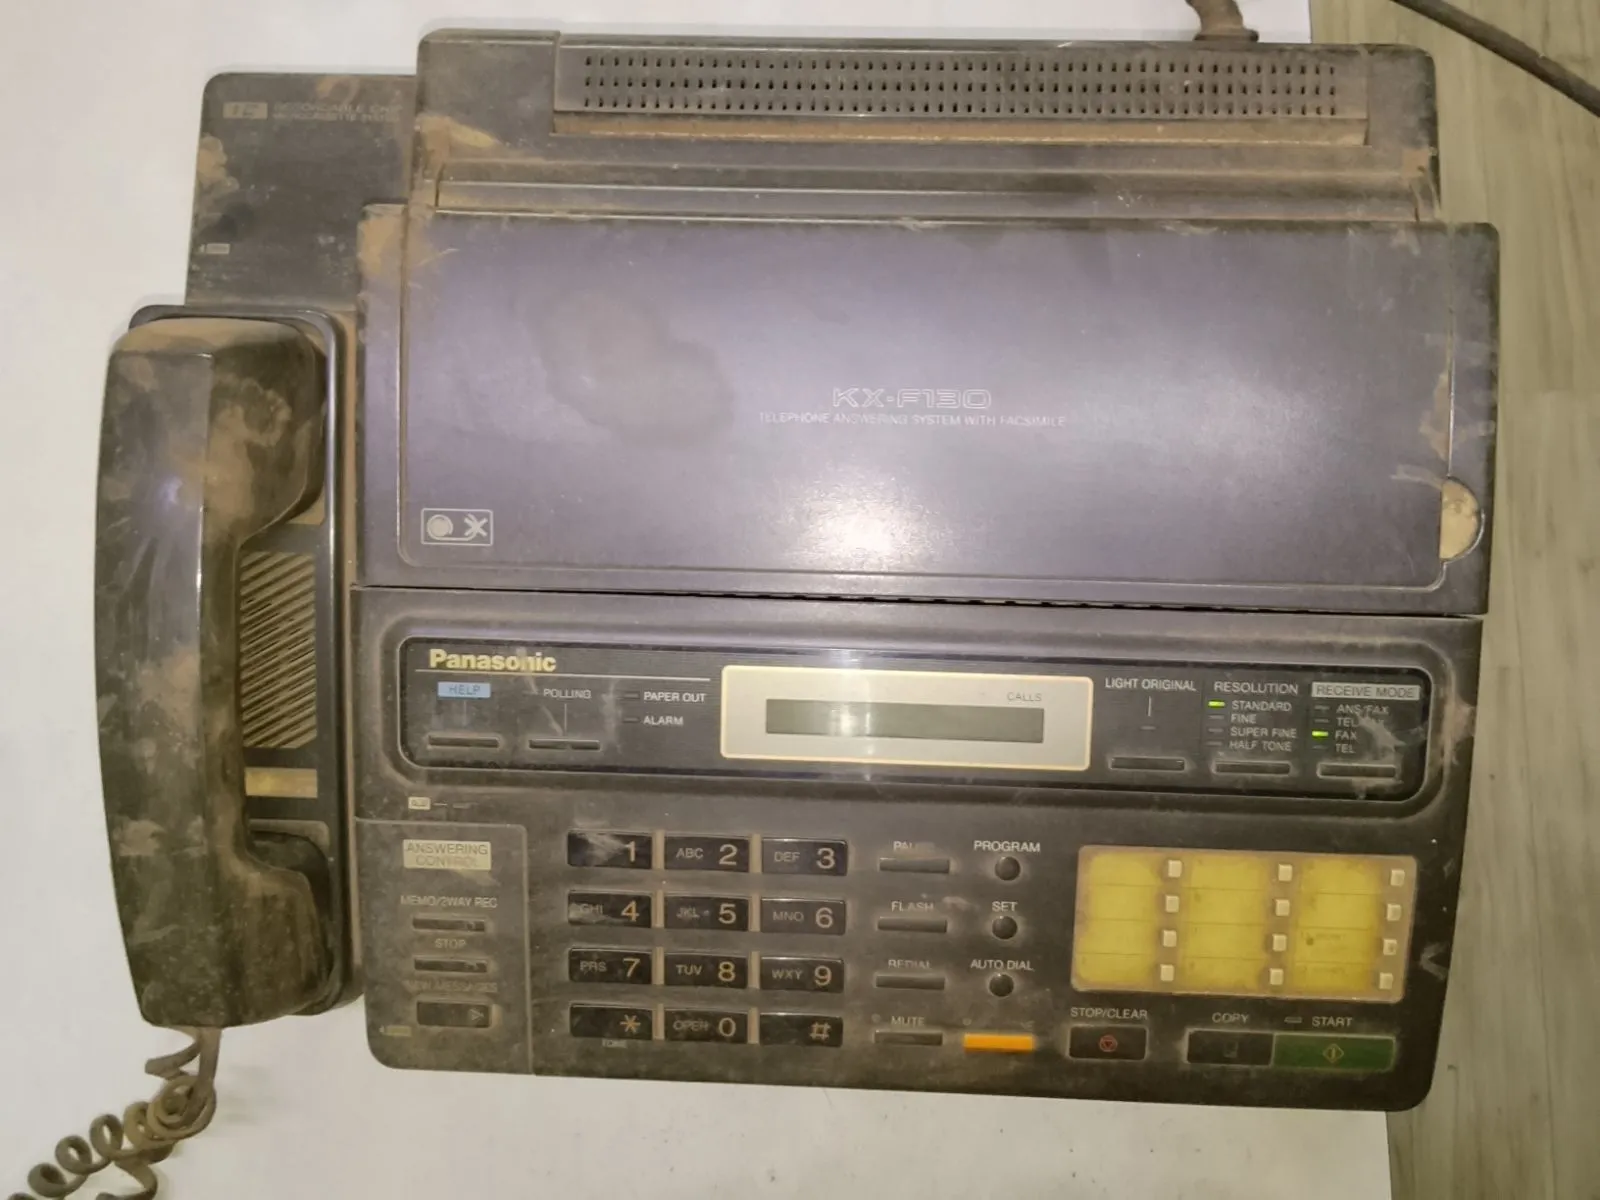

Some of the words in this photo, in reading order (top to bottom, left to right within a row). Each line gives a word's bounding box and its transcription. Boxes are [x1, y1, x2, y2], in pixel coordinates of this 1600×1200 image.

[831, 387, 992, 410] KX-F130
[759, 411, 831, 424] TELEPHONE
[911, 414, 961, 426] SYSTEM
[964, 415, 996, 428] WITH
[999, 416, 1066, 428] FACSIMILE
[429, 648, 557, 673] Panasonic
[448, 683, 481, 696] HELP
[1104, 677, 1138, 690] LIGHT
[1141, 678, 1197, 692] ORIGINAL
[1213, 681, 1299, 695] RESOLUTION
[542, 688, 592, 700] POLLING
[643, 691, 680, 703] PAPER
[683, 693, 706, 704] OUT
[1006, 691, 1043, 702] CALLS
[1316, 684, 1372, 698] RECEIVE
[1375, 686, 1416, 699] MODE
[1231, 700, 1293, 712] STANDARD
[643, 715, 684, 727] ALARM
[1230, 713, 1257, 724] FINE
[1229, 726, 1269, 738] SUPER
[1271, 727, 1297, 739] FINE
[1334, 729, 1357, 741] FAX
[1228, 739, 1258, 751] HALF
[1262, 740, 1293, 753] TONE
[1335, 743, 1356, 754] TEL
[406, 842, 489, 856] ANSWERING
[625, 840, 637, 862] 1
[973, 840, 1041, 853] PROGRAM
[675, 847, 704, 860] ABC
[718, 843, 739, 866] 2
[773, 851, 800, 863] DEF
[815, 847, 836, 869] 3
[474, 897, 498, 909] REC
[891, 901, 934, 912] FLASH
[991, 901, 1018, 912] SET
[620, 900, 640, 922] 4
[676, 907, 699, 919] JKL
[718, 903, 737, 925] 5
[772, 911, 804, 923] MNO
[814, 906, 834, 928] 6
[434, 938, 467, 950] STOP
[579, 960, 607, 973] PRS
[622, 957, 641, 978] 7
[675, 964, 703, 976] TUV
[717, 960, 737, 982] 8
[970, 959, 1004, 971] AUTO
[1006, 960, 1034, 972] DIAL
[771, 968, 803, 981] WXY
[813, 965, 833, 986] 9
[1070, 1007, 1148, 1020] STOP/CLEAR
[1211, 1012, 1250, 1025] COPY
[891, 1015, 926, 1028] MUTE
[1311, 1017, 1352, 1029] START
[807, 1021, 832, 1041] #
